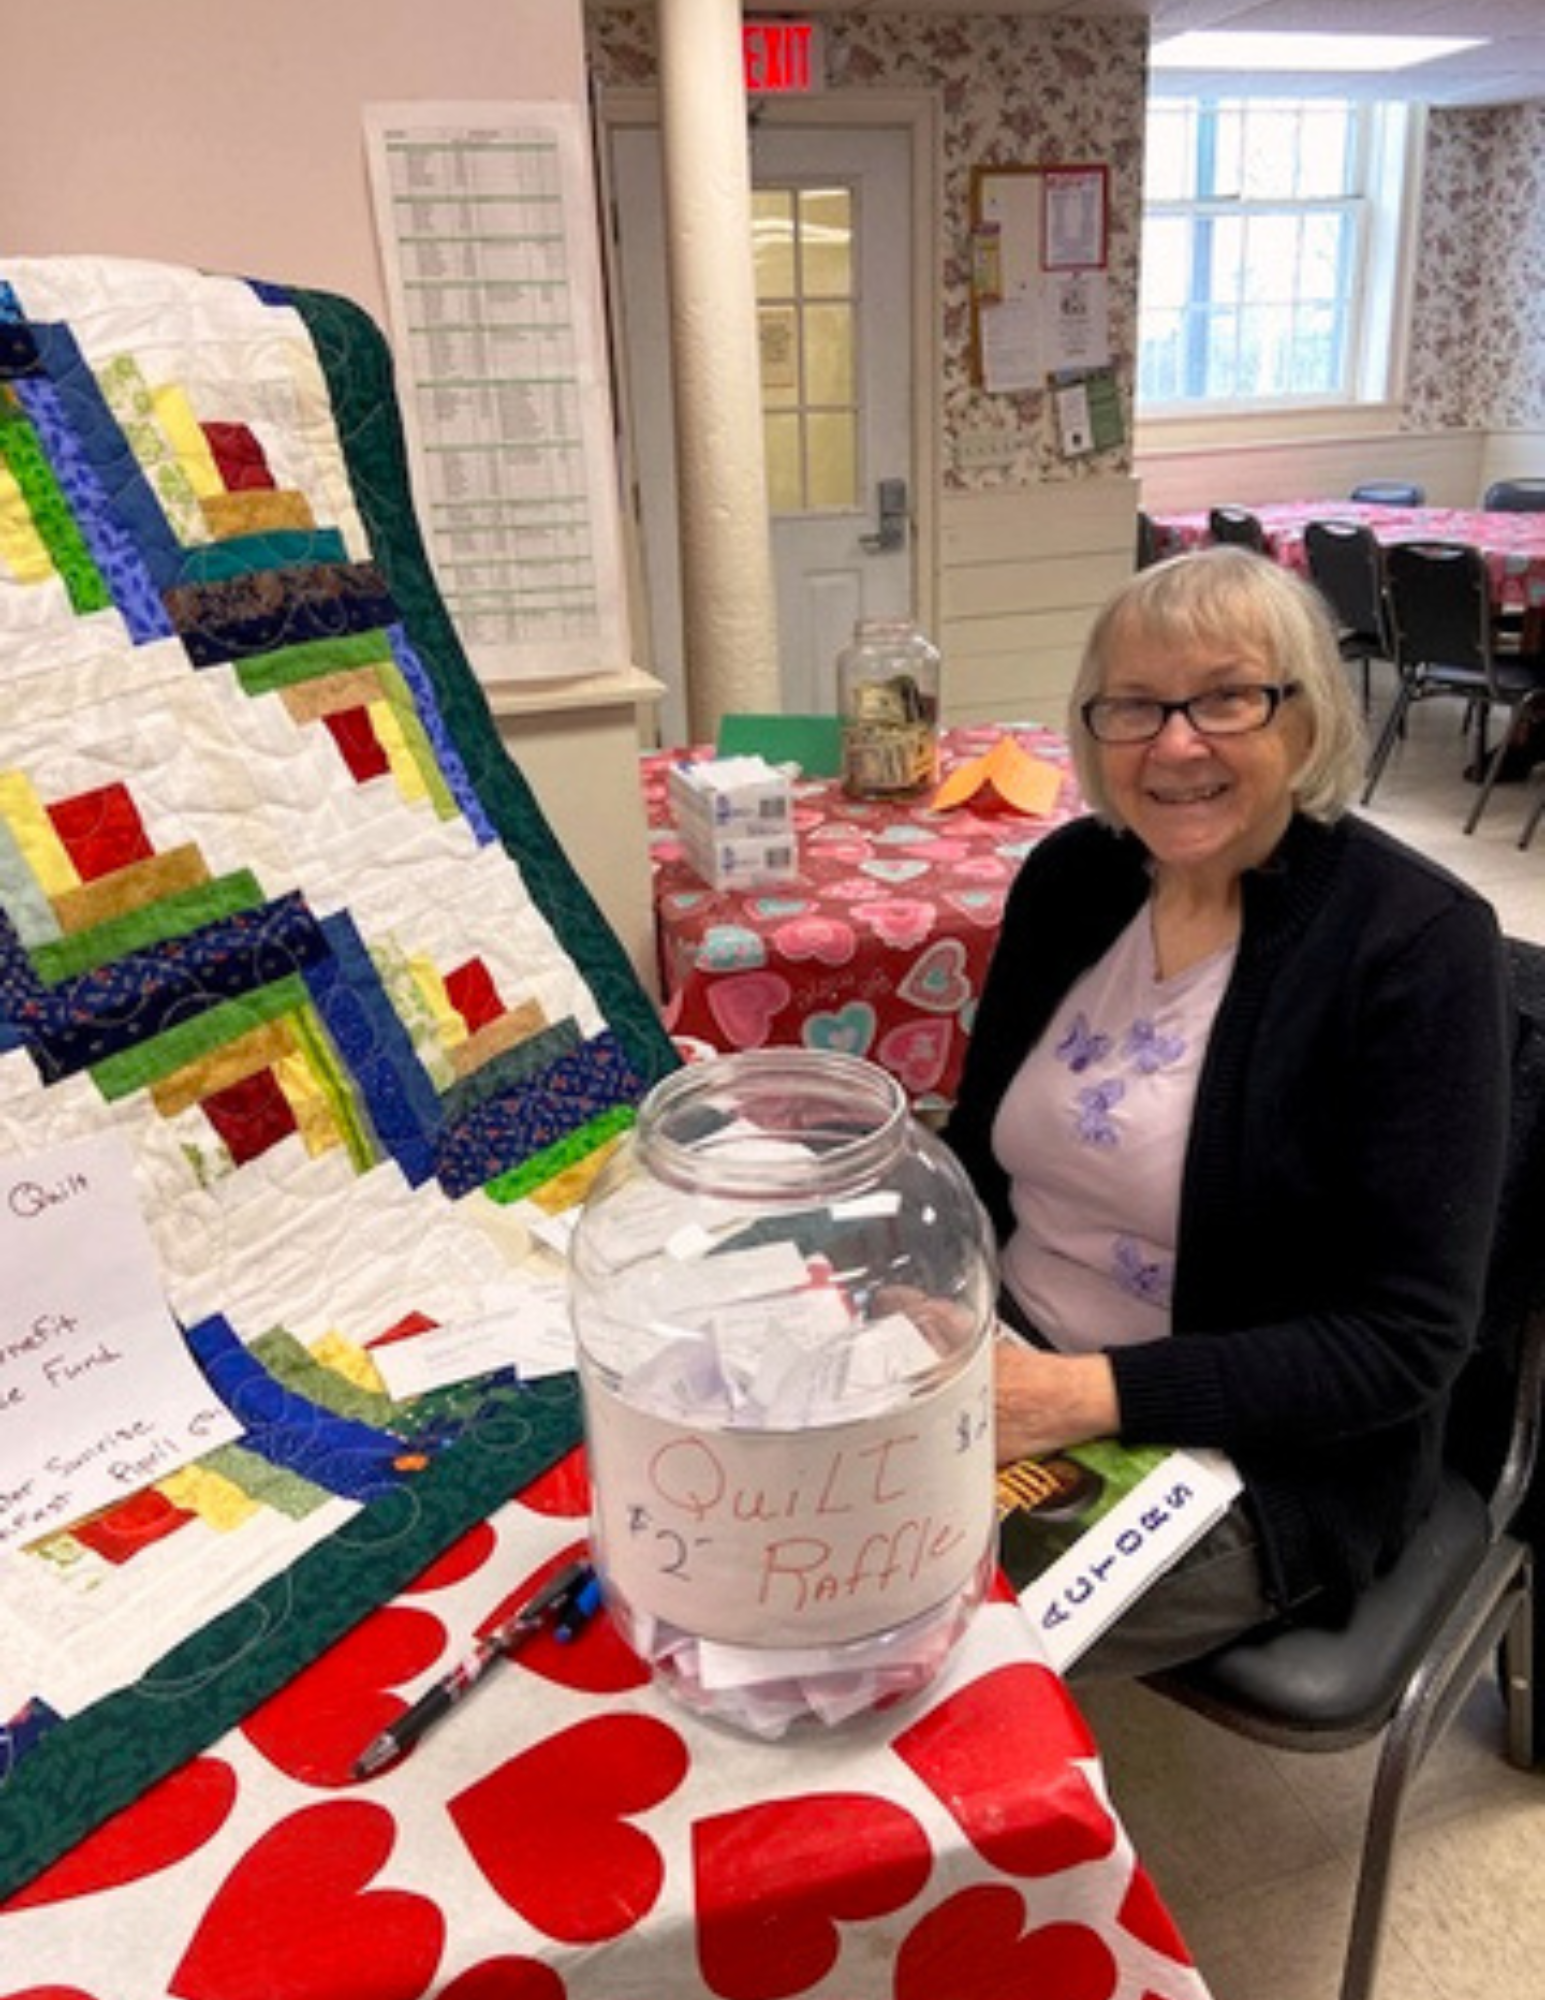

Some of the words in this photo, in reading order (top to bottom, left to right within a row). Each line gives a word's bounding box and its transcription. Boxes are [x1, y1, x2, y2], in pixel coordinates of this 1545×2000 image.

[743, 26, 811, 90] EXIT
[8, 1173, 88, 1218] Quilt
[43, 1343, 123, 1388] Fund
[1041, 1483, 1194, 1630] ACTORS
